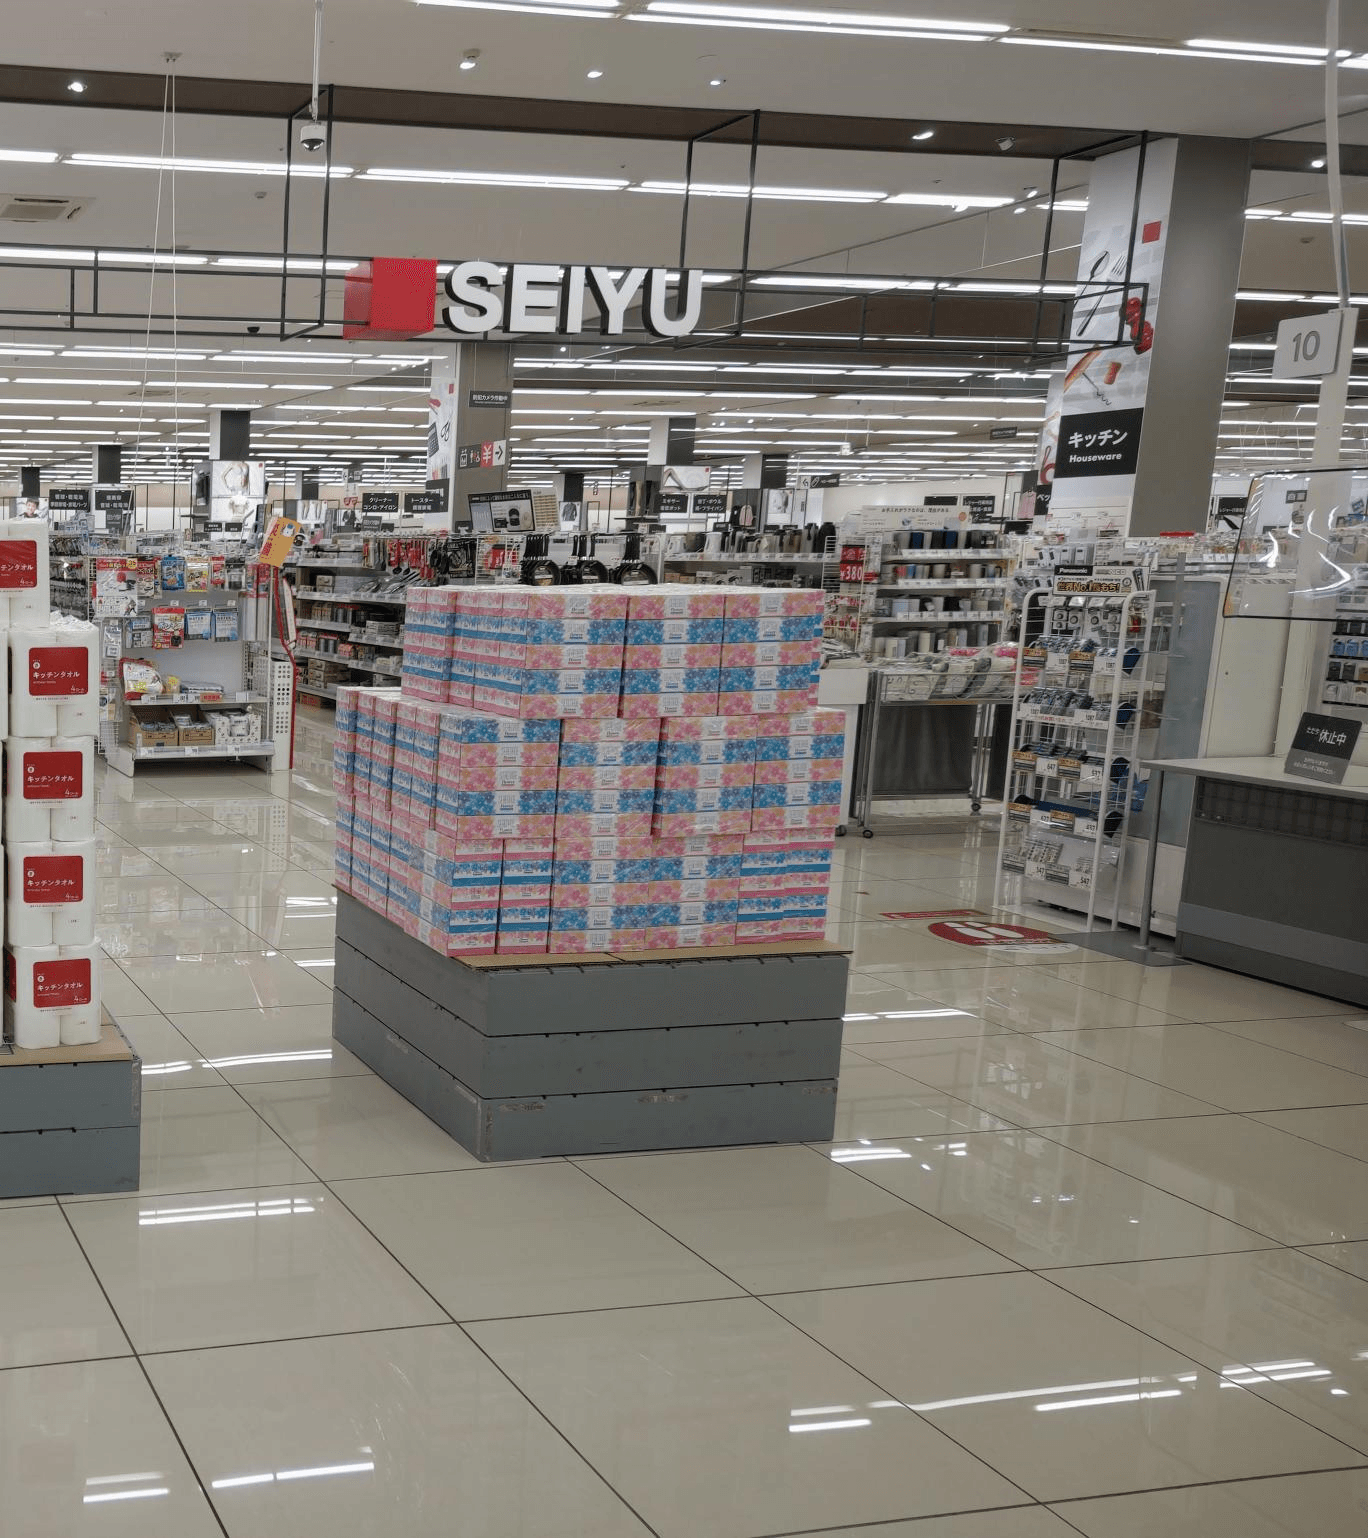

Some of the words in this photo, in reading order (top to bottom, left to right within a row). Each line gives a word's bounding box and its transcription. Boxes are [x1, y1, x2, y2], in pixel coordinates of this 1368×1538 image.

[442, 260, 703, 337] SEIYU
[1292, 330, 1321, 362] 10
[1068, 429, 1128, 448] キッチン
[1069, 453, 1122, 463] Houseware
[32, 670, 81, 680] キッチンタオル
[27, 775, 75, 783] キッチンタオル
[26, 878, 76, 887] キッチンタオル
[36, 982, 84, 991] キッチンタオル
